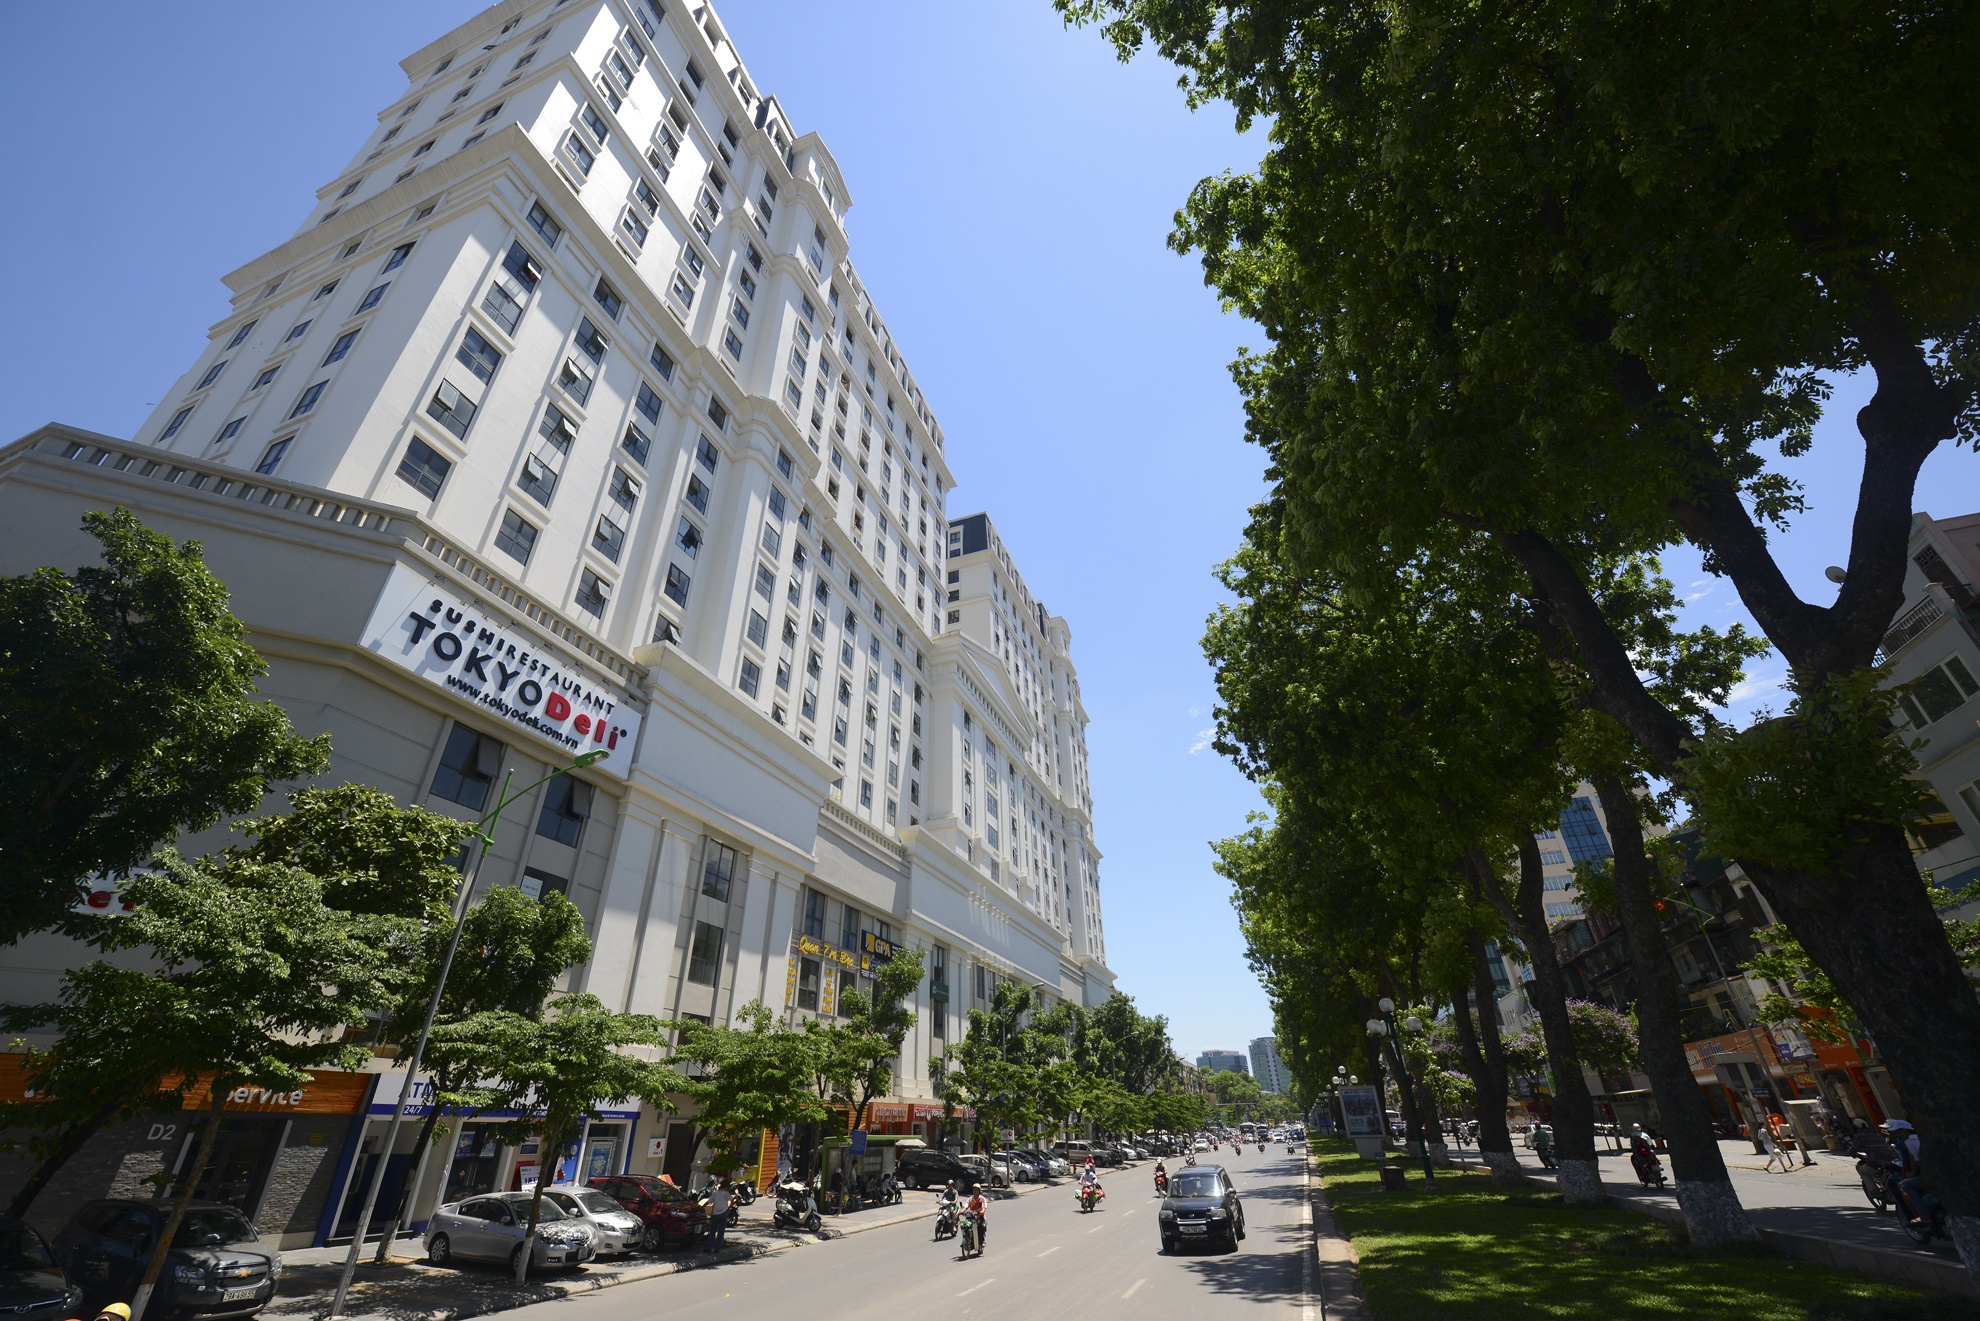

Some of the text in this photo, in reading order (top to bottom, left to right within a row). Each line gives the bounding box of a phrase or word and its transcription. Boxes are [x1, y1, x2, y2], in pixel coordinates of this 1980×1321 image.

[447, 674, 579, 749] www.tokyodeli.com.vn
[875, 938, 892, 957] GPA
[399, 1082, 437, 1099] TM
[404, 1105, 422, 1114] 24/7
[146, 1123, 177, 1141] D2
